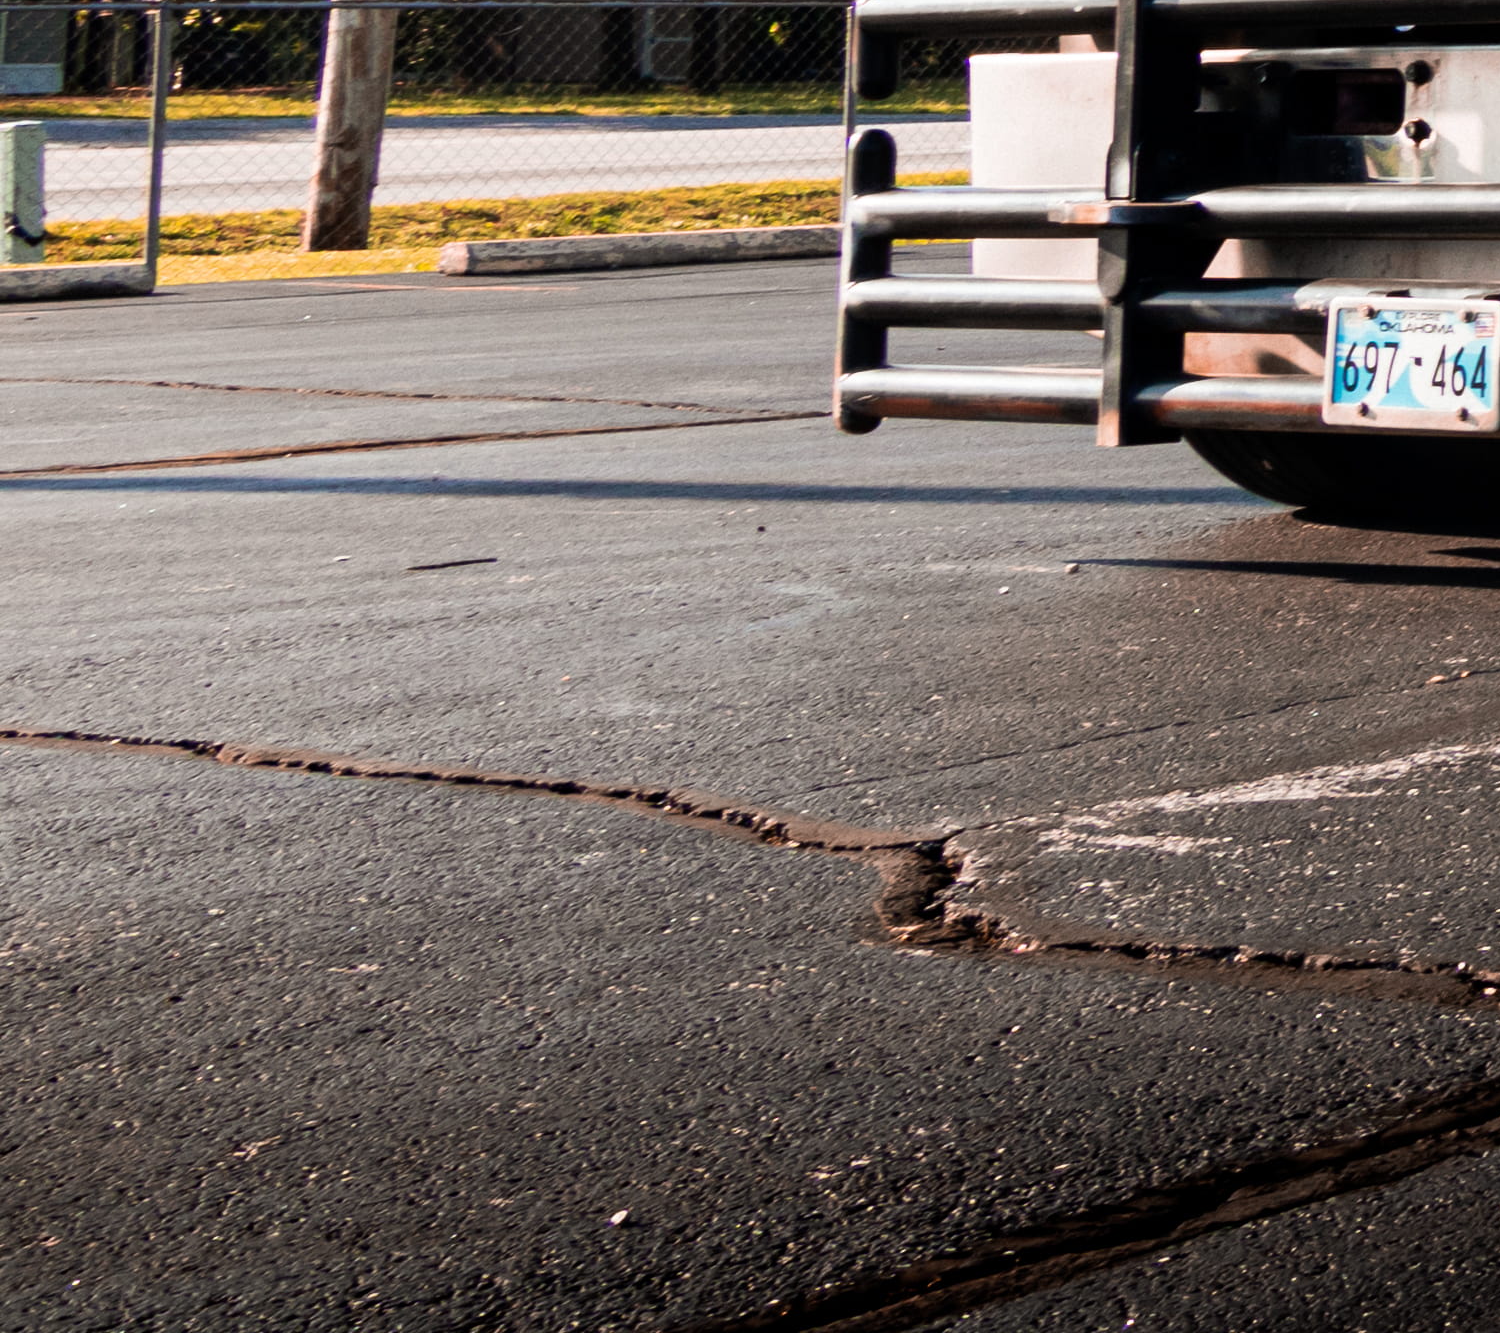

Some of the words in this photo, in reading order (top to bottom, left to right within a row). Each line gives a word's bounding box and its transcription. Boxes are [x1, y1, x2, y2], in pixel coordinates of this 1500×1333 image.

[1379, 321, 1455, 334] OKLAHOMA
[1343, 341, 1399, 394] 697
[1431, 344, 1487, 399] 464
